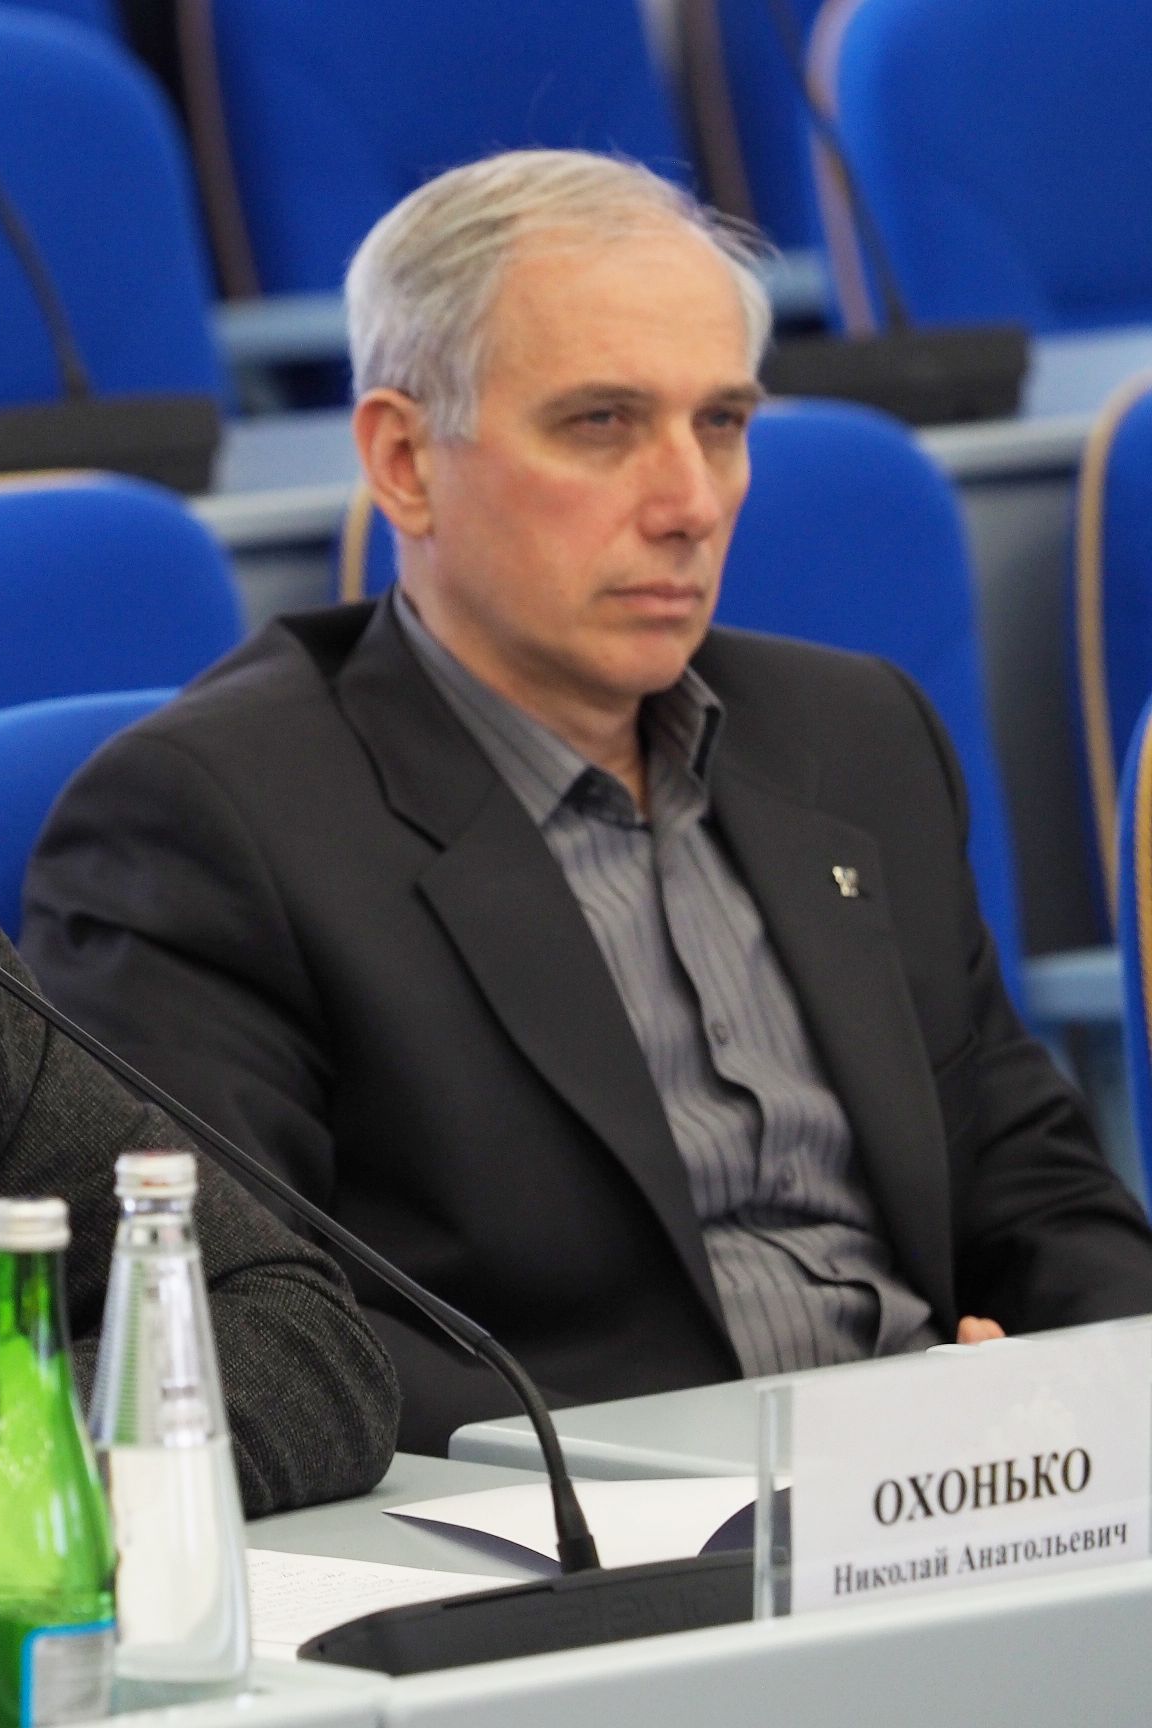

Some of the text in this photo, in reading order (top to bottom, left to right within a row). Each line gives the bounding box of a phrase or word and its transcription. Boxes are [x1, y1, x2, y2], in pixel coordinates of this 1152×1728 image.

[872, 1447, 1092, 1526] ОХОНЬКО
[834, 1521, 1129, 1596] Николай Анатольевич
